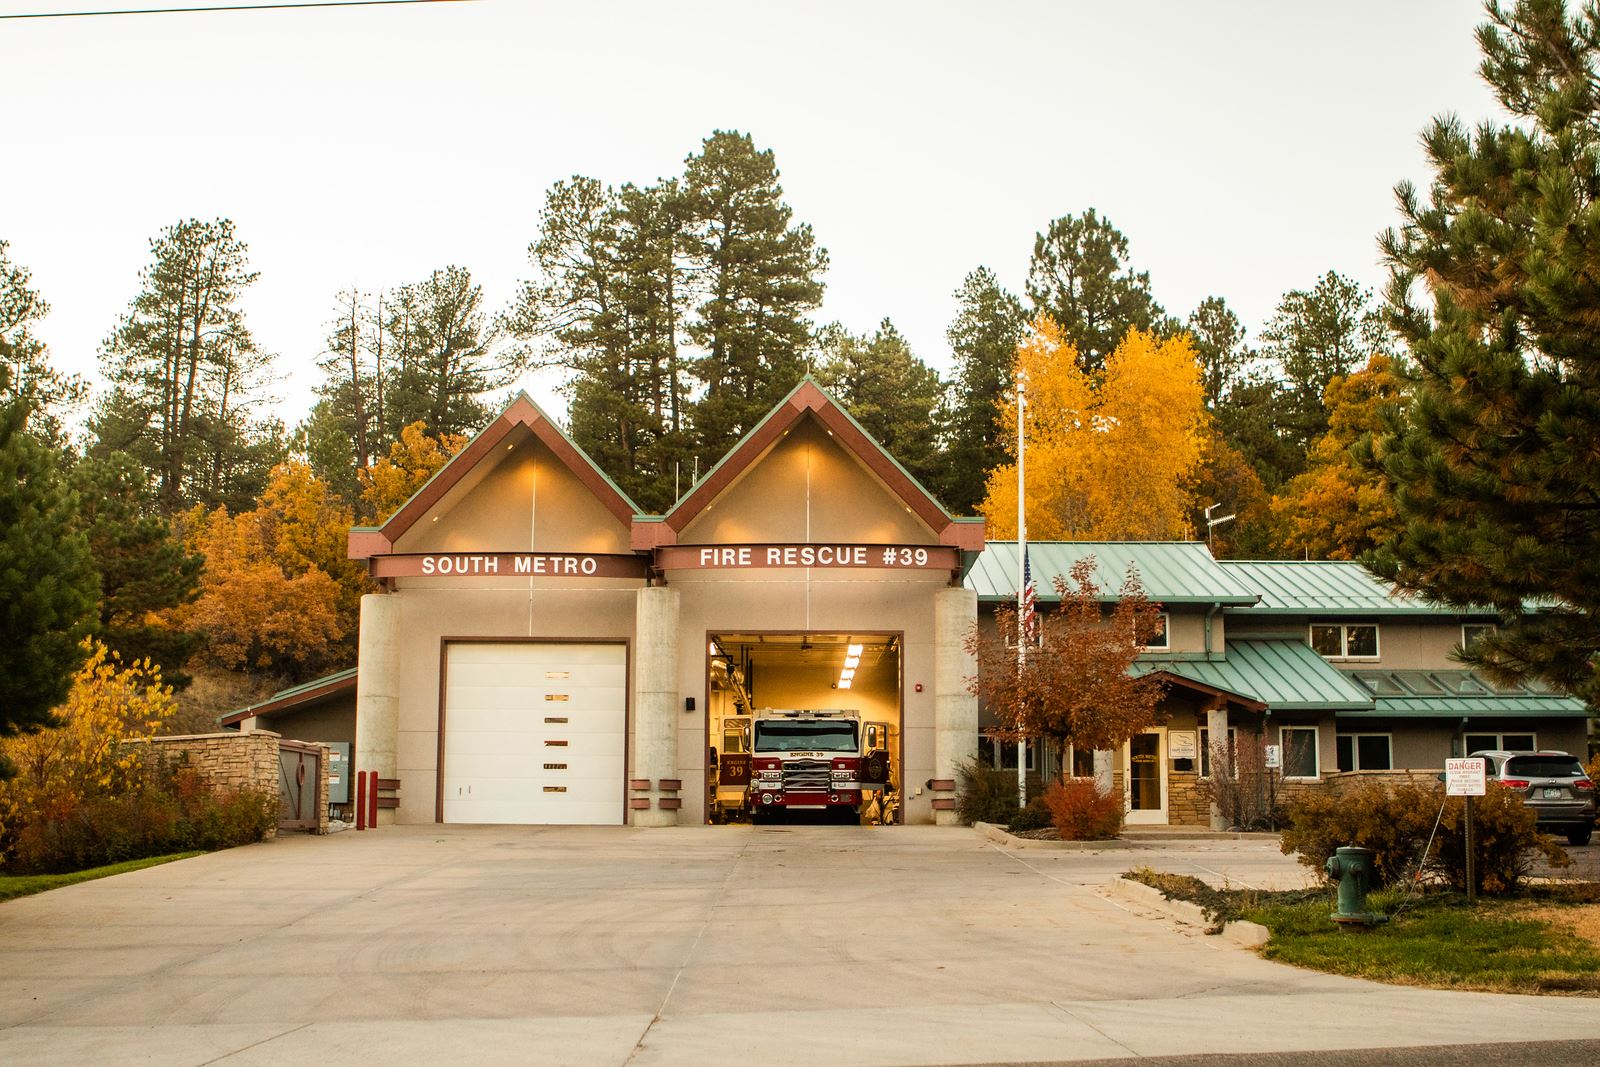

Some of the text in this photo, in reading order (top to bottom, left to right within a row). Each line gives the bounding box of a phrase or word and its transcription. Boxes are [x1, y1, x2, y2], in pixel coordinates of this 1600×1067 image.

[700, 546, 928, 566] FIRE RESCUE #39
[421, 556, 597, 574] SOUTH METRO
[730, 765, 743, 777] 39
[1448, 761, 1482, 770] DANGER
